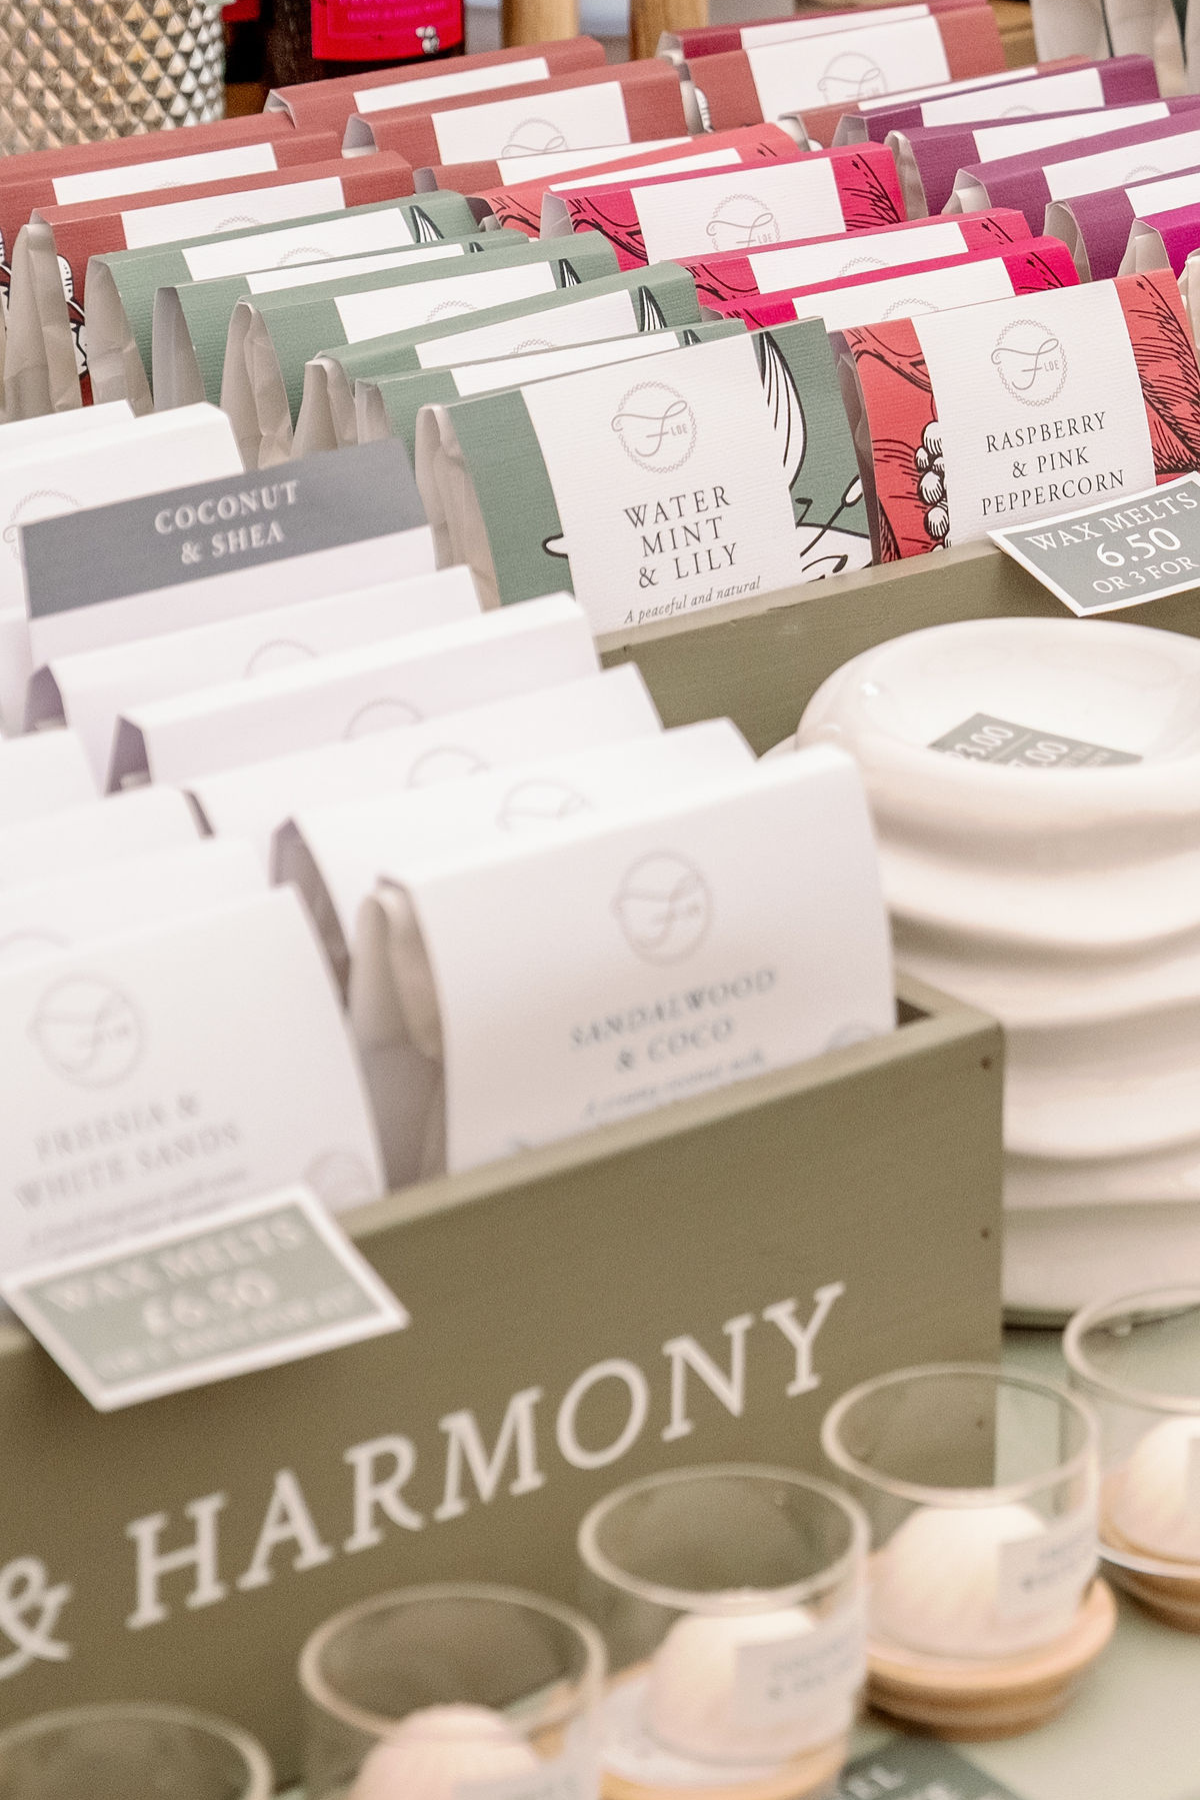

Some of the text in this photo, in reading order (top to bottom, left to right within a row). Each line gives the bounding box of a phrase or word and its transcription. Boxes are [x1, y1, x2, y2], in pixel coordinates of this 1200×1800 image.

[986, 411, 1106, 454] RASPBERRY
[1012, 446, 1091, 480] & PINK
[154, 480, 298, 535] COCONUT
[623, 485, 732, 530] WATER
[981, 469, 1125, 517] PEPPERCORN
[181, 520, 287, 566] & SHEA
[641, 516, 724, 558] MINT
[1024, 491, 1199, 552] WAX MELTS
[639, 542, 738, 589] & LILY
[1096, 527, 1182, 568] 6.50
[1092, 575, 1131, 595] OR
[1128, 570, 1147, 586] 3
[1144, 555, 1200, 581] FOR
[624, 575, 762, 625] A peaceful and natural
[571, 967, 778, 1046] SANDALWOOD
[616, 1014, 734, 1074] & COCO
[14, 1154, 125, 1211] WHITE
[134, 1118, 242, 1173] SANDS
[47, 1212, 302, 1313] WAX MELTS
[0, 1281, 846, 1679] & HARMONY
